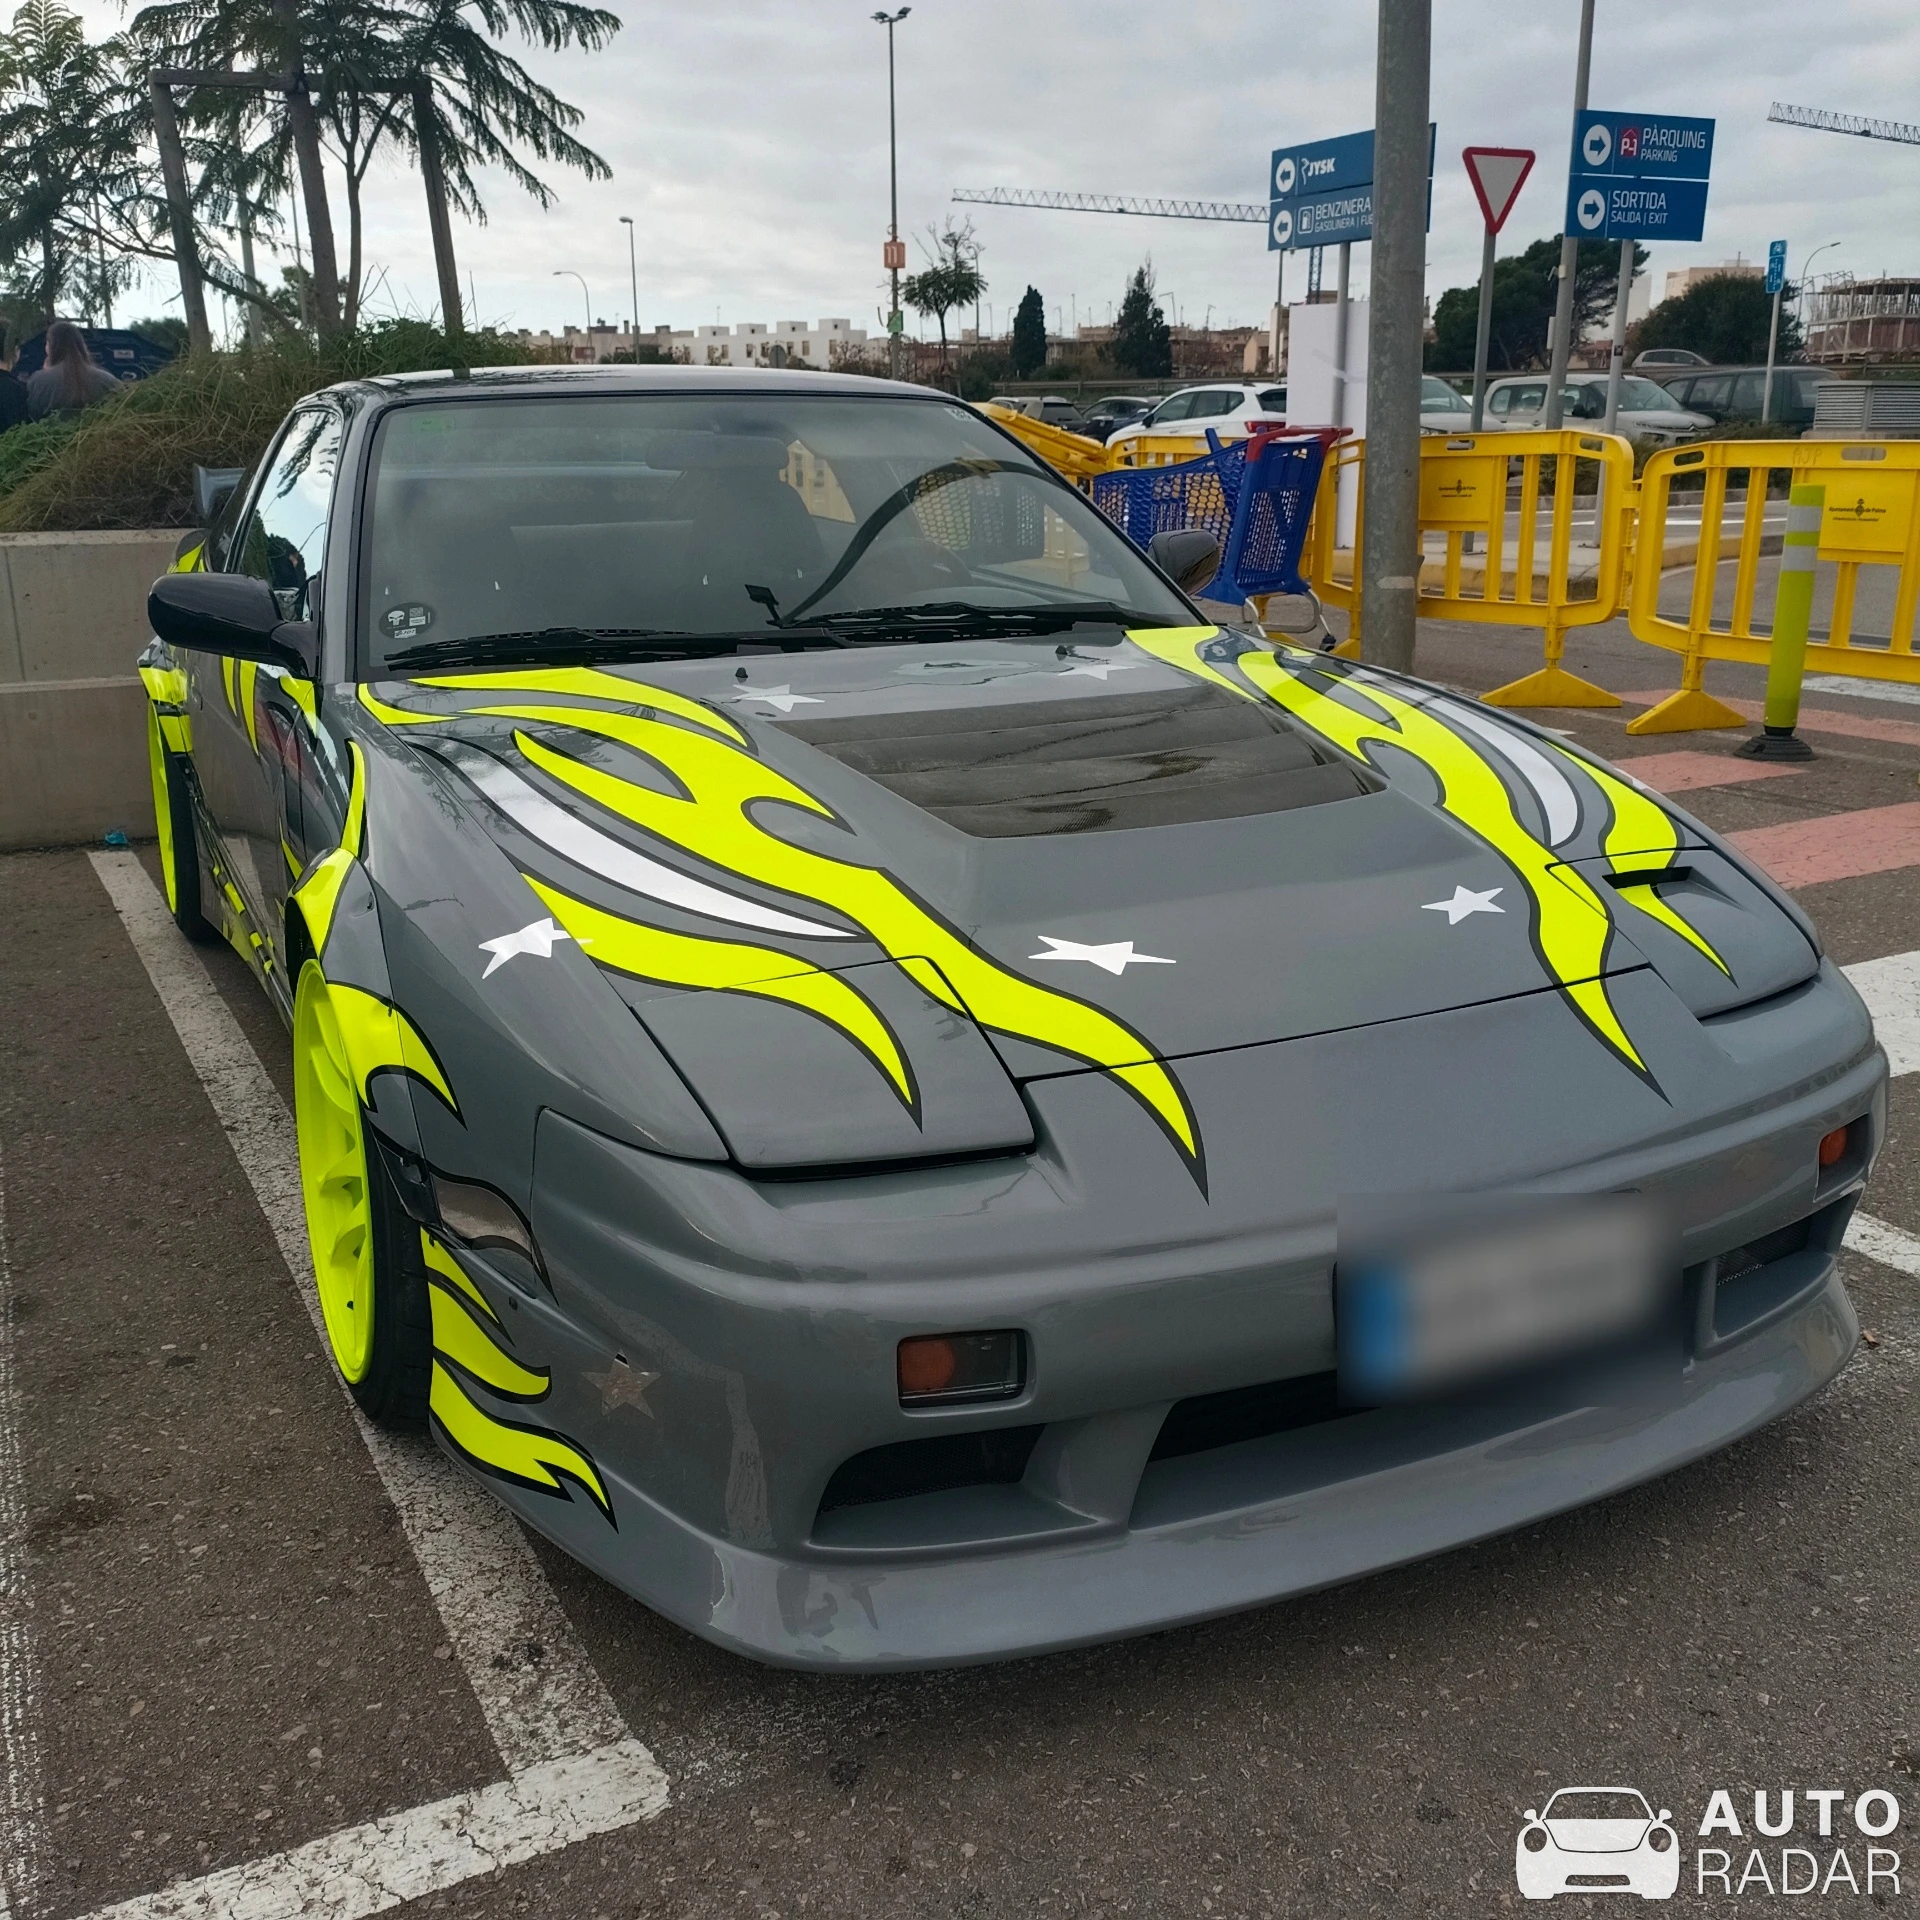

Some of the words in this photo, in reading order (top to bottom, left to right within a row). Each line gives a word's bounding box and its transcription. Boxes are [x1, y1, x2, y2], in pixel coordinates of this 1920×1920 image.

[1642, 124, 1706, 149] PÀRQUING
[1640, 149, 1678, 162] PARKING
[1307, 157, 1336, 177] JYSK
[1315, 197, 1372, 220] BENZINERA
[1612, 190, 1667, 209] SORTIDA
[1314, 216, 1355, 233] GASOLINERA
[1361, 213, 1374, 226] FUE
[1611, 210, 1641, 224] SALIDA
[1648, 212, 1668, 225] EXIT
